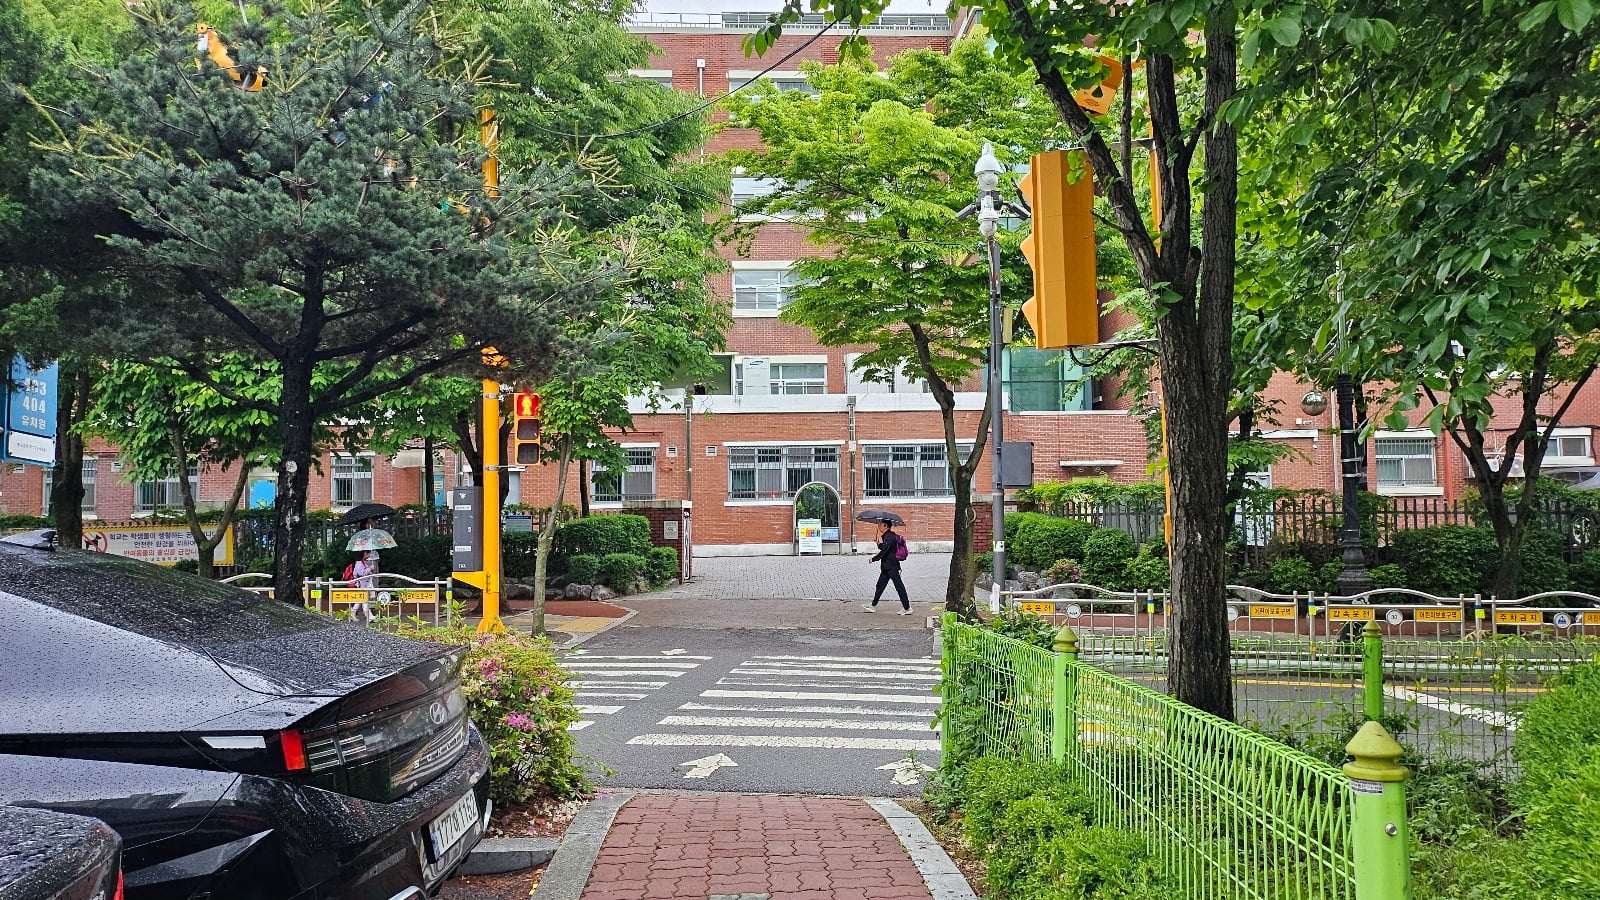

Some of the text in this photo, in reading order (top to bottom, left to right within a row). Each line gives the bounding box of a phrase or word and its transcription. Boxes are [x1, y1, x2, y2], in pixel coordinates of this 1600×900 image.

[23, 397, 46, 413] 404
[21, 415, 46, 430] 유치원
[130, 532, 156, 540] 학생들이
[159, 531, 184, 540] 생활하는
[133, 541, 153, 549] 안전한
[123, 549, 155, 557] 반려동물의
[178, 548, 197, 556] 금합니
[1254, 607, 1291, 616] 어린이보호구역
[1333, 610, 1370, 618] 감속운전
[1419, 611, 1457, 620] 어린이보호구역
[1500, 613, 1537, 622] 주차금지
